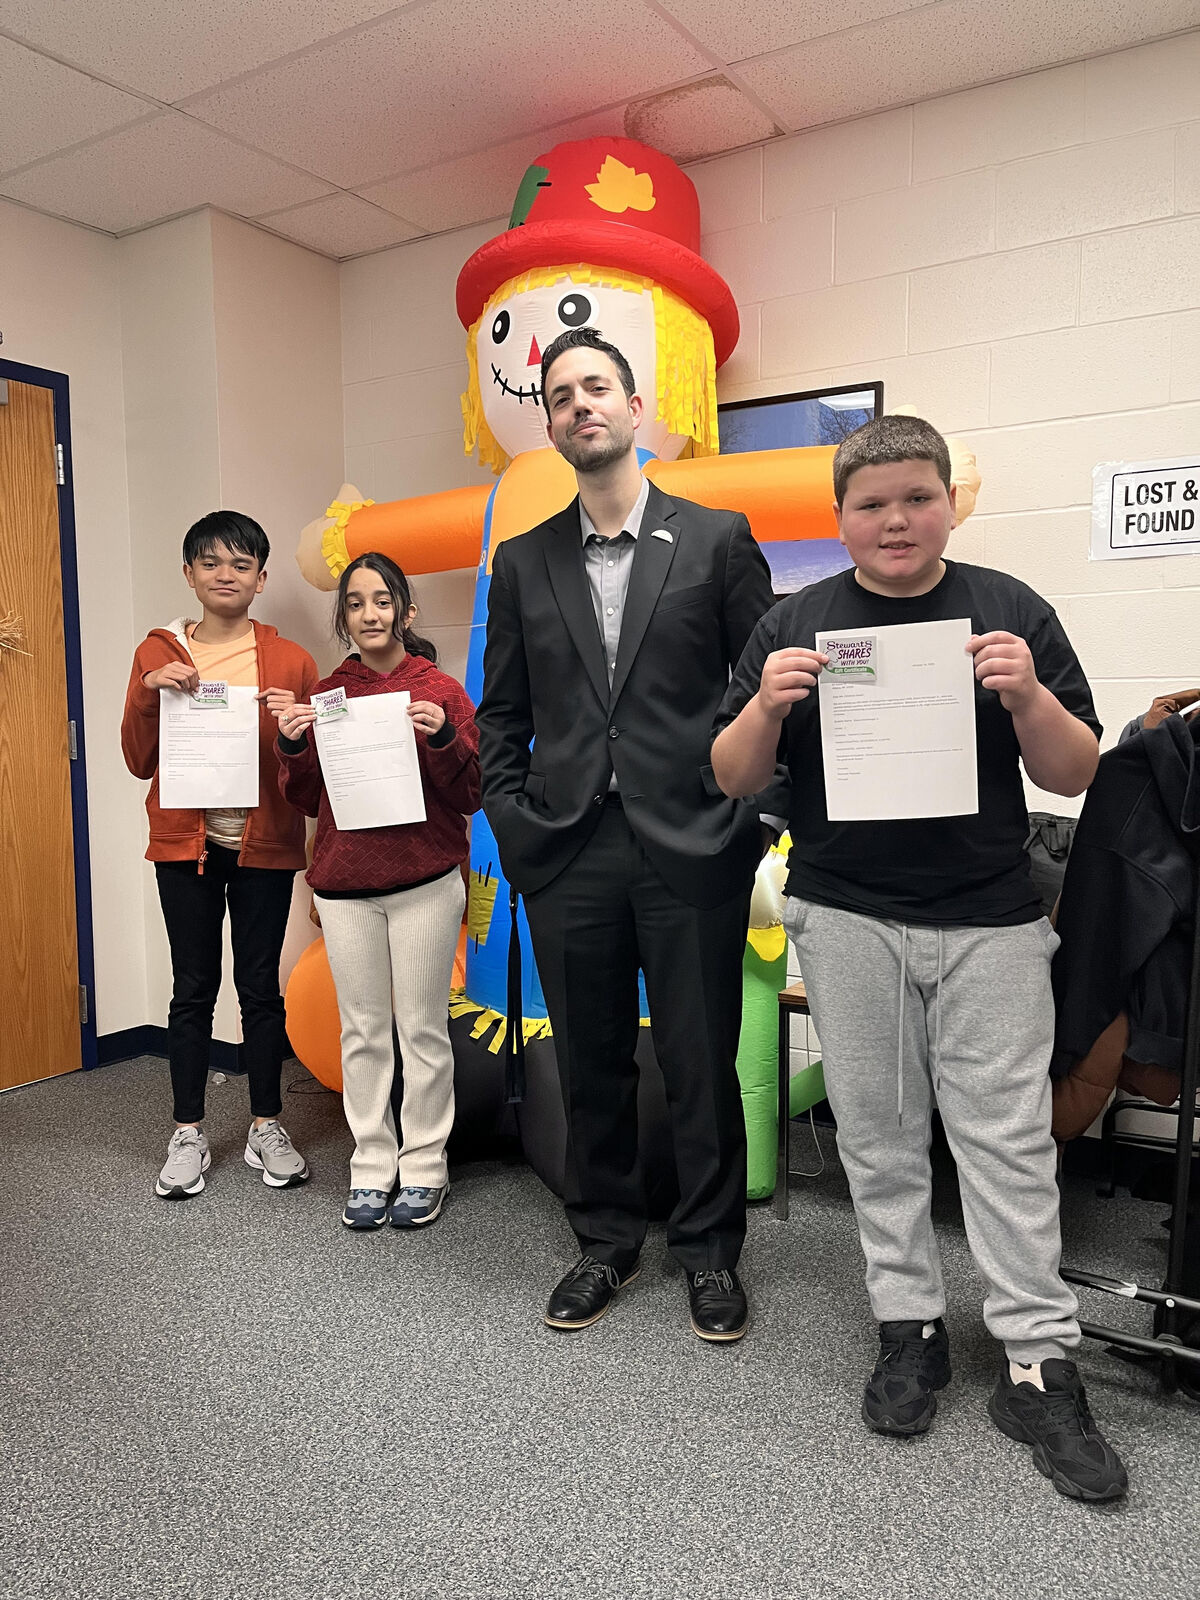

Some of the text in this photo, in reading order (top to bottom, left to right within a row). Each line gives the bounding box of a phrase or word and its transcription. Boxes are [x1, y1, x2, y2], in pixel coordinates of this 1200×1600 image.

[1124, 479, 1199, 507] LOST &
[1125, 509, 1195, 535] FOUND
[838, 647, 872, 660] SHARES
[323, 695, 343, 707] SHARES
